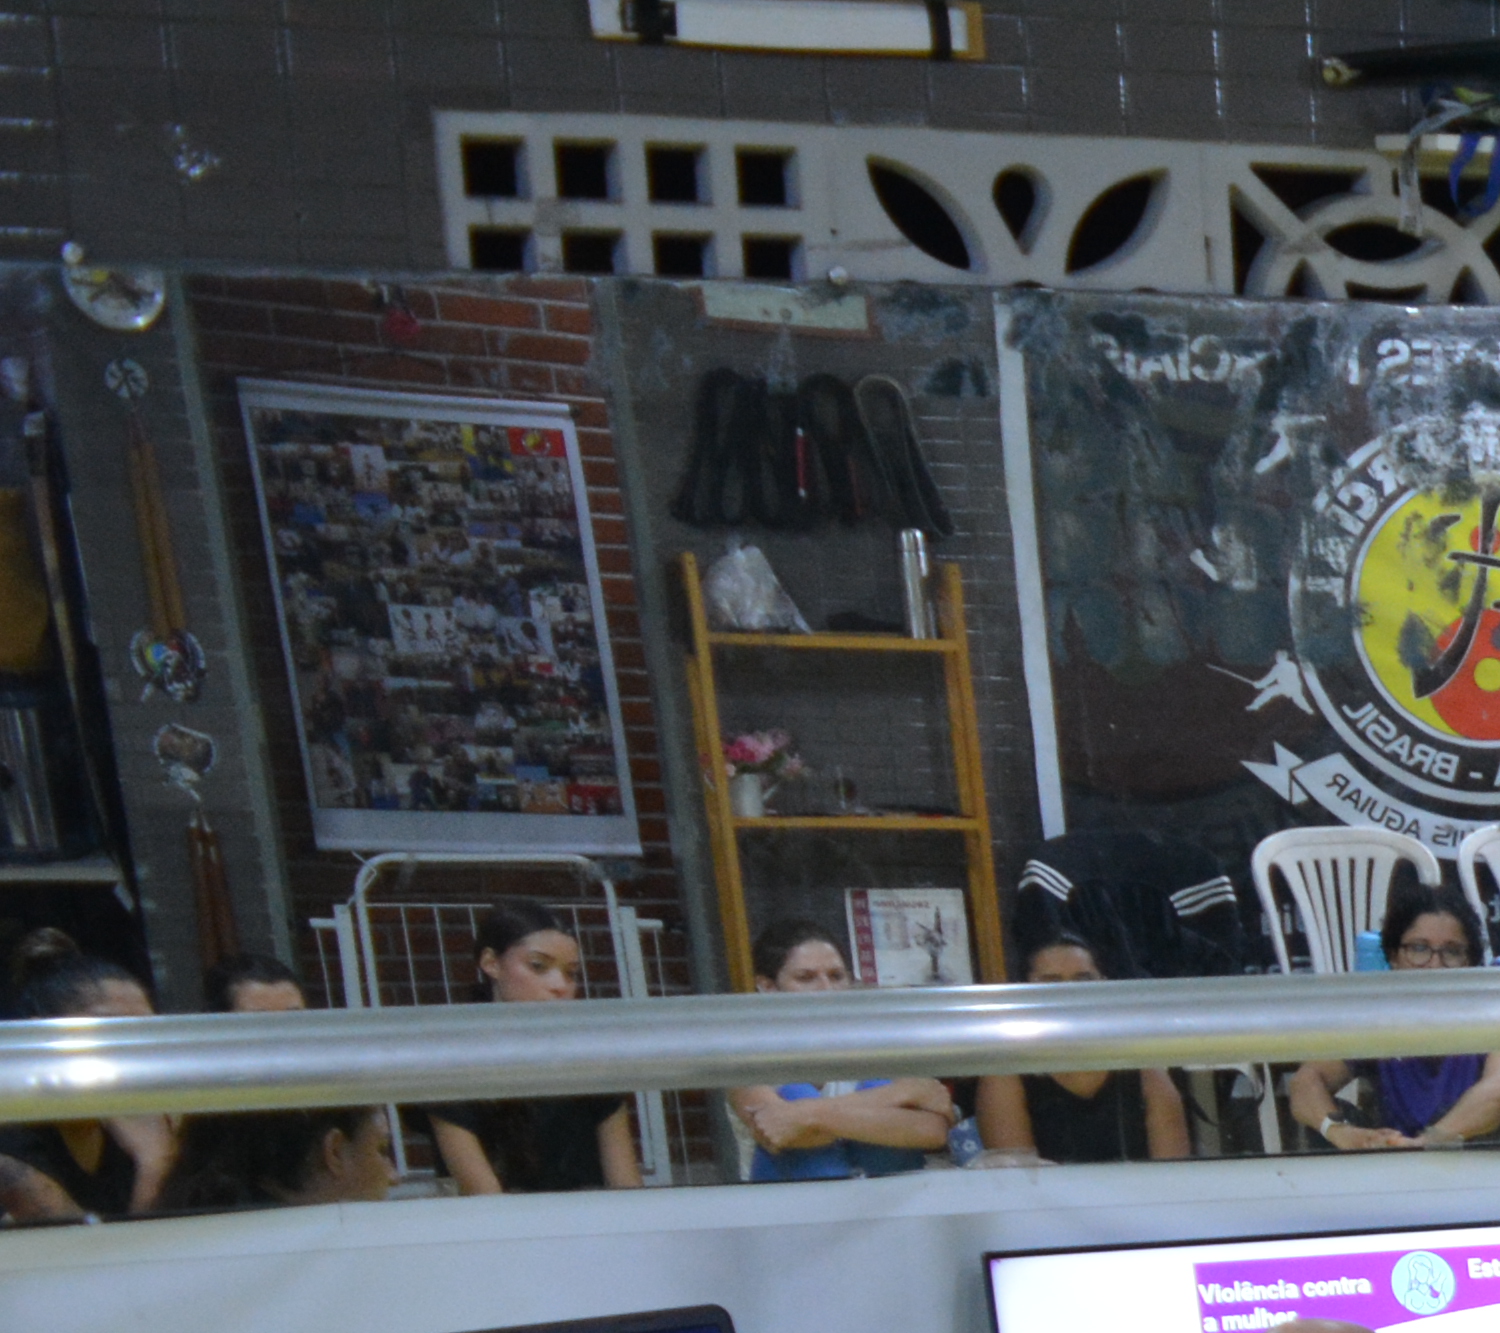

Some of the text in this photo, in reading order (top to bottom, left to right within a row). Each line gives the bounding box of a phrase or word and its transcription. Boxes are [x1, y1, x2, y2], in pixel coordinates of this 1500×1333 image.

[1197, 1275, 1372, 1305] Violência contra
[1203, 1316, 1218, 1332] a
